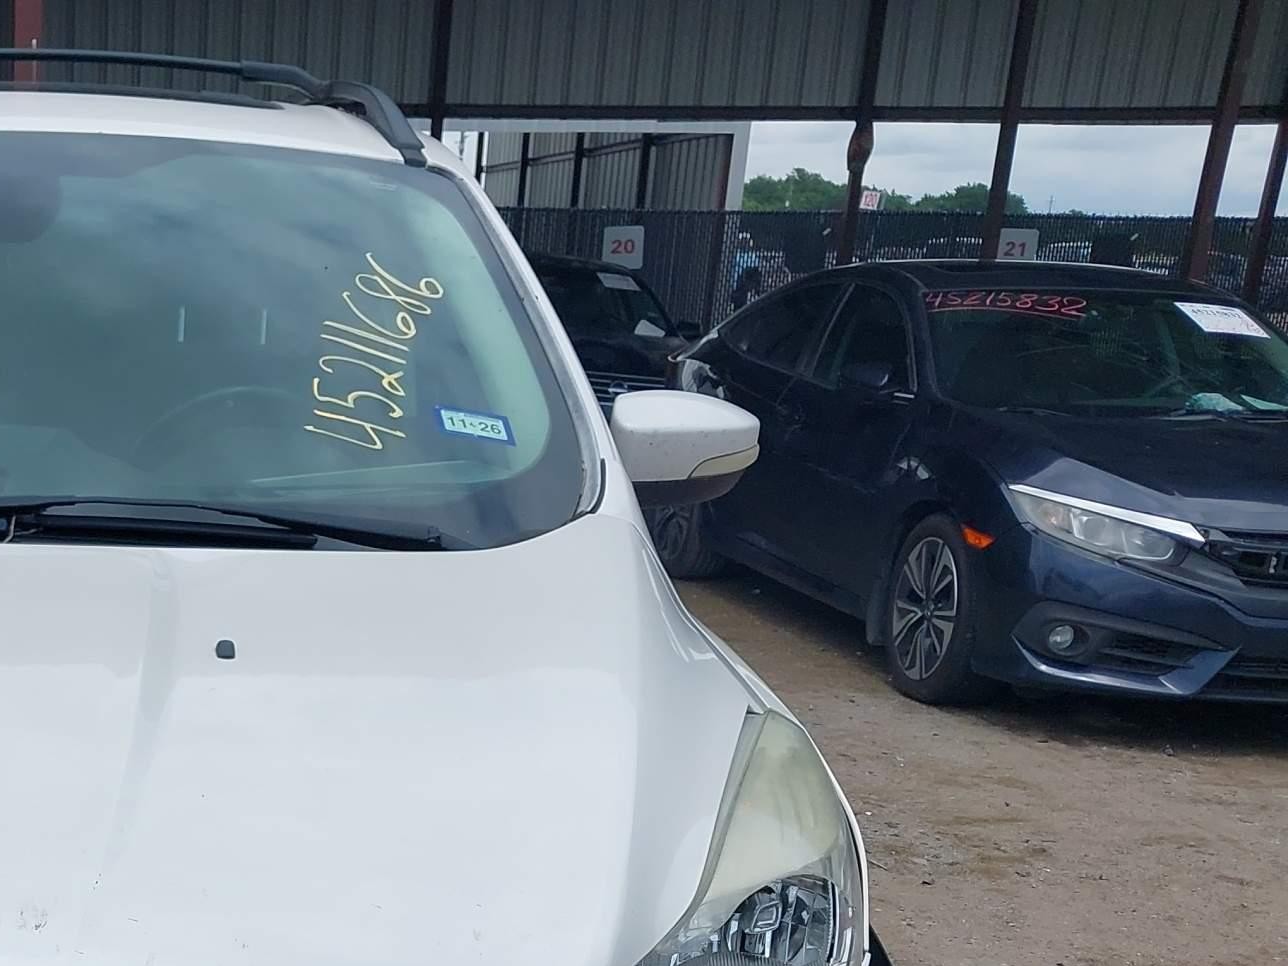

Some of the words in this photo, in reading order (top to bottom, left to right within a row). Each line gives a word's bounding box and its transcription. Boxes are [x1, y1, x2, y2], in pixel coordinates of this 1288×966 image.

[610, 239, 636, 254] 20
[1005, 241, 1027, 256] 21
[925, 291, 1087, 317] 45215832
[303, 252, 444, 449] 45211686
